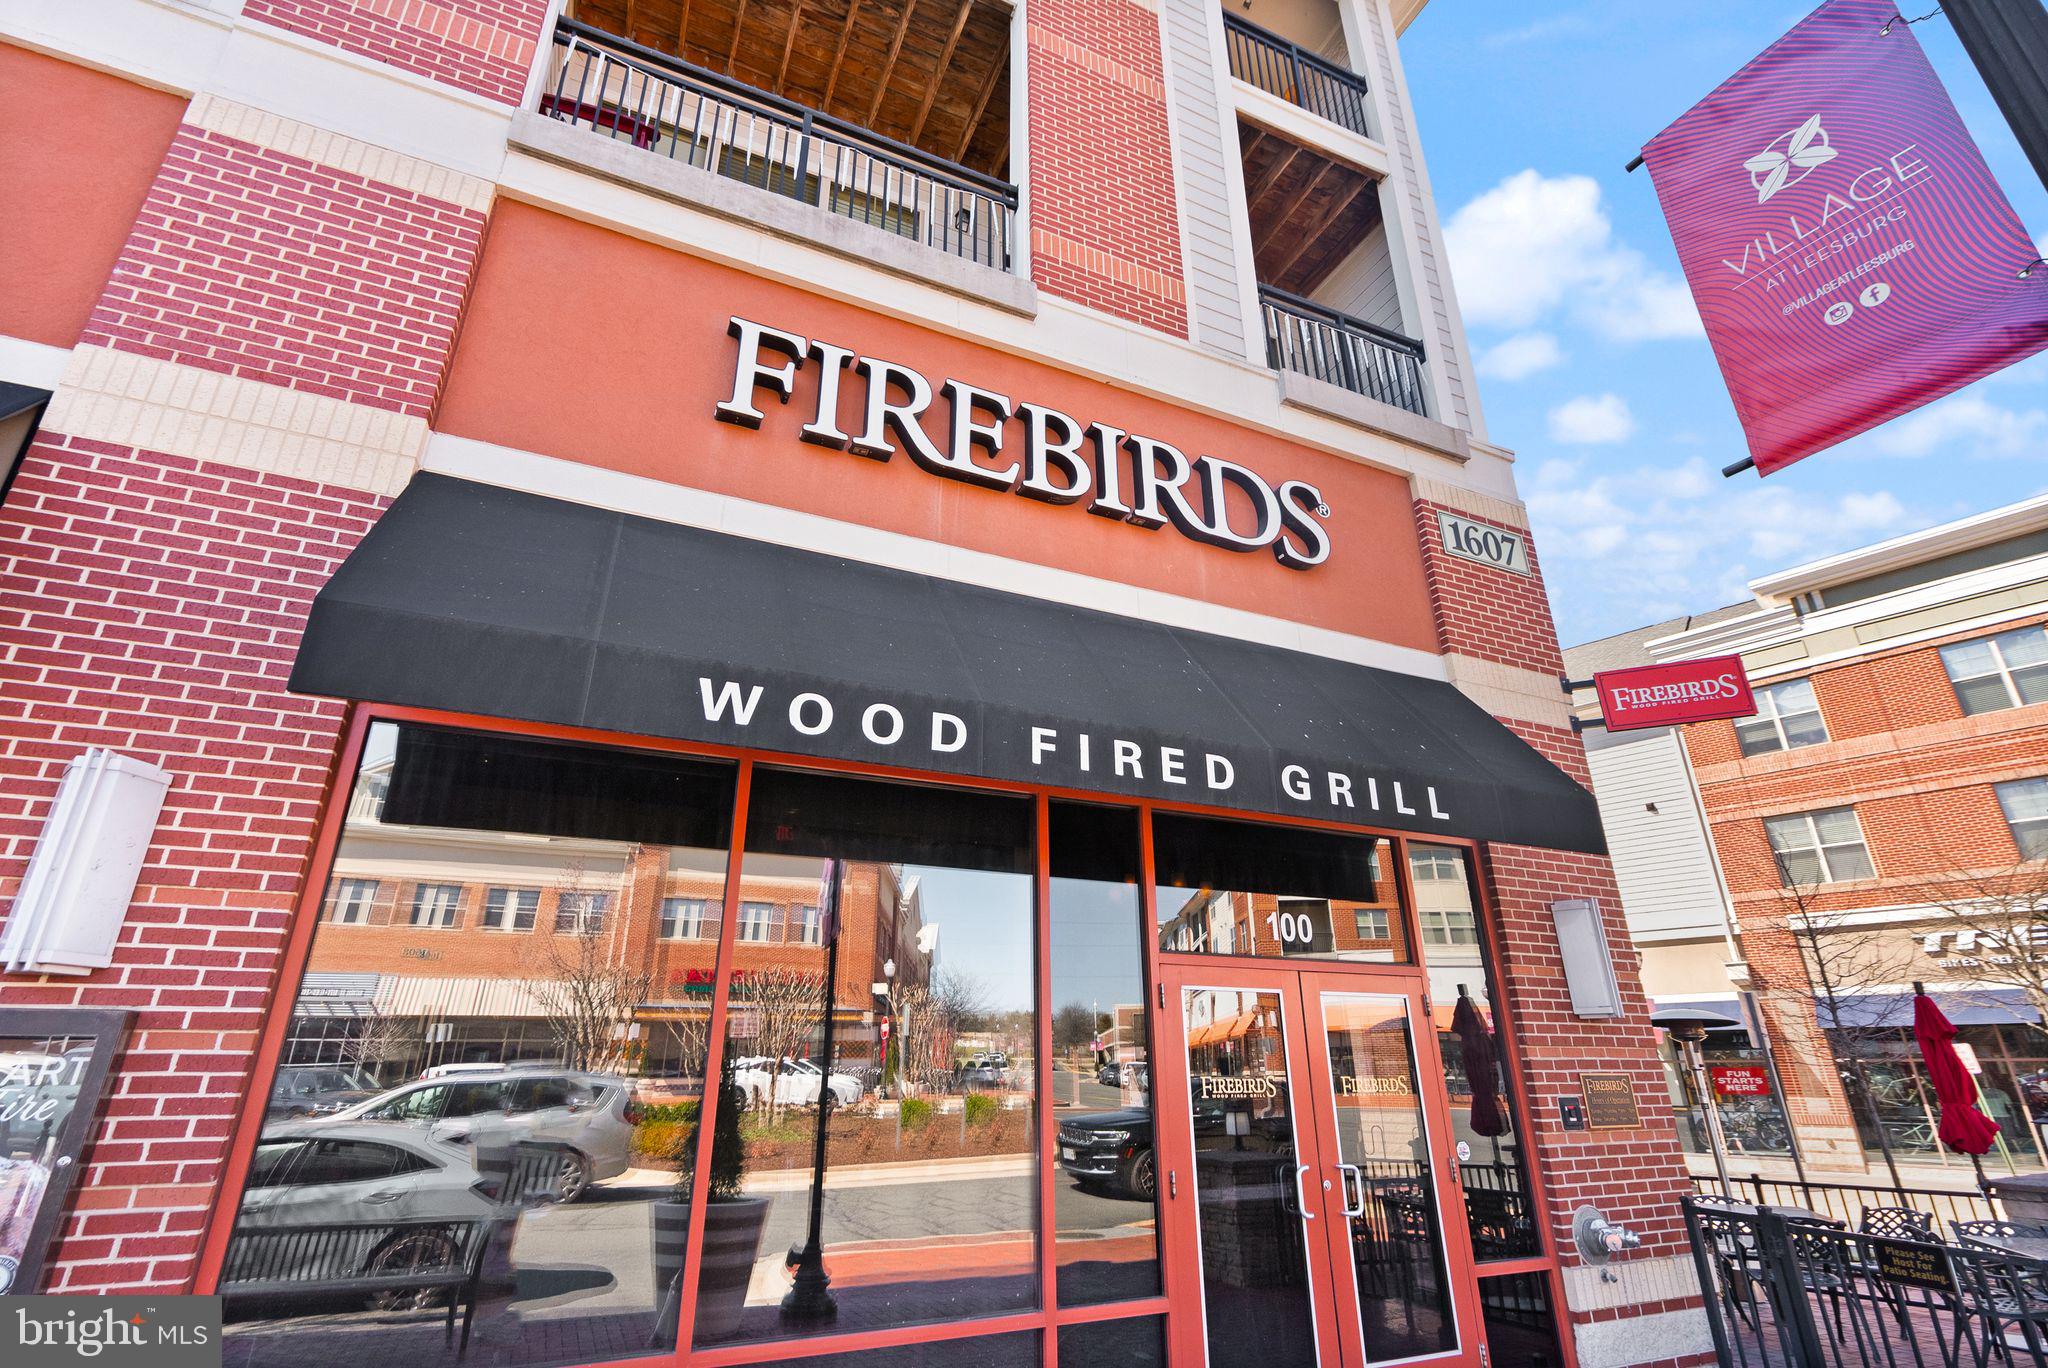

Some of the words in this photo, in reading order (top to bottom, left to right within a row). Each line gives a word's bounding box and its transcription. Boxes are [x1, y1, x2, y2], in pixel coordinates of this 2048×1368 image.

[1722, 144, 1929, 275] VILLAGE
[1766, 269, 1786, 292] AT
[1792, 205, 1907, 275] LEESBURG
[1782, 239, 1916, 316] @VILLAGEATLEESBURG
[1448, 521, 1516, 566] 1607
[699, 677, 968, 753] WOOD
[1031, 726, 1235, 790] FIRED
[1281, 764, 1450, 820] GRILL
[1266, 911, 1313, 943] 100
[1200, 1076, 1277, 1098] FIREBIRDS
[1340, 1075, 1408, 1097] FIREBIRDS
[1585, 1079, 1629, 1094] FIREBIRDS
[1717, 1077, 1764, 1085] STARTS
[1884, 1246, 1915, 1258] Please
[1917, 1251, 1936, 1262] See
[1892, 1256, 1915, 1268] Host
[1916, 1260, 1933, 1271] For
[1882, 1264, 1908, 1277] Patio
